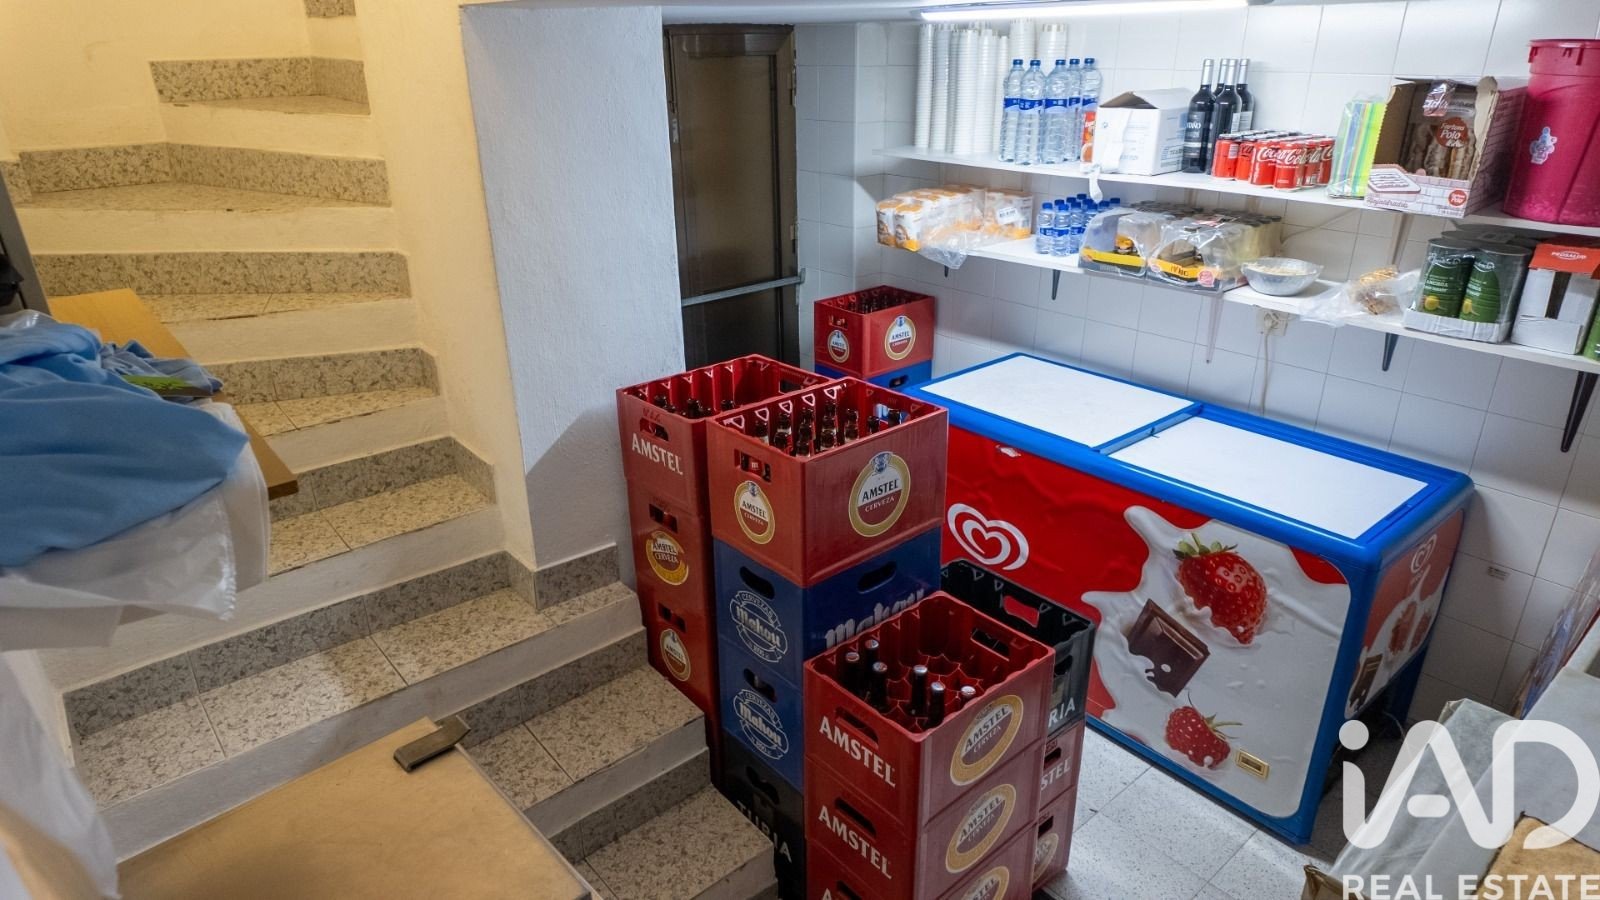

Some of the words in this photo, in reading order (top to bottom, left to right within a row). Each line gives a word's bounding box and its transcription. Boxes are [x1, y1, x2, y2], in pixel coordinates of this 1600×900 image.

[632, 432, 683, 476] AMSTEL
[742, 500, 767, 518] AMSTEL
[862, 478, 900, 502] AMSTEL
[864, 496, 895, 512] CERVEZA
[736, 605, 781, 648] Mahou
[739, 702, 782, 747] Mahou
[965, 706, 1009, 750] AMSTEL
[819, 715, 896, 788] AMSTEL
[959, 796, 1003, 842] AMSTEL
[818, 805, 892, 880] AMSTEL
